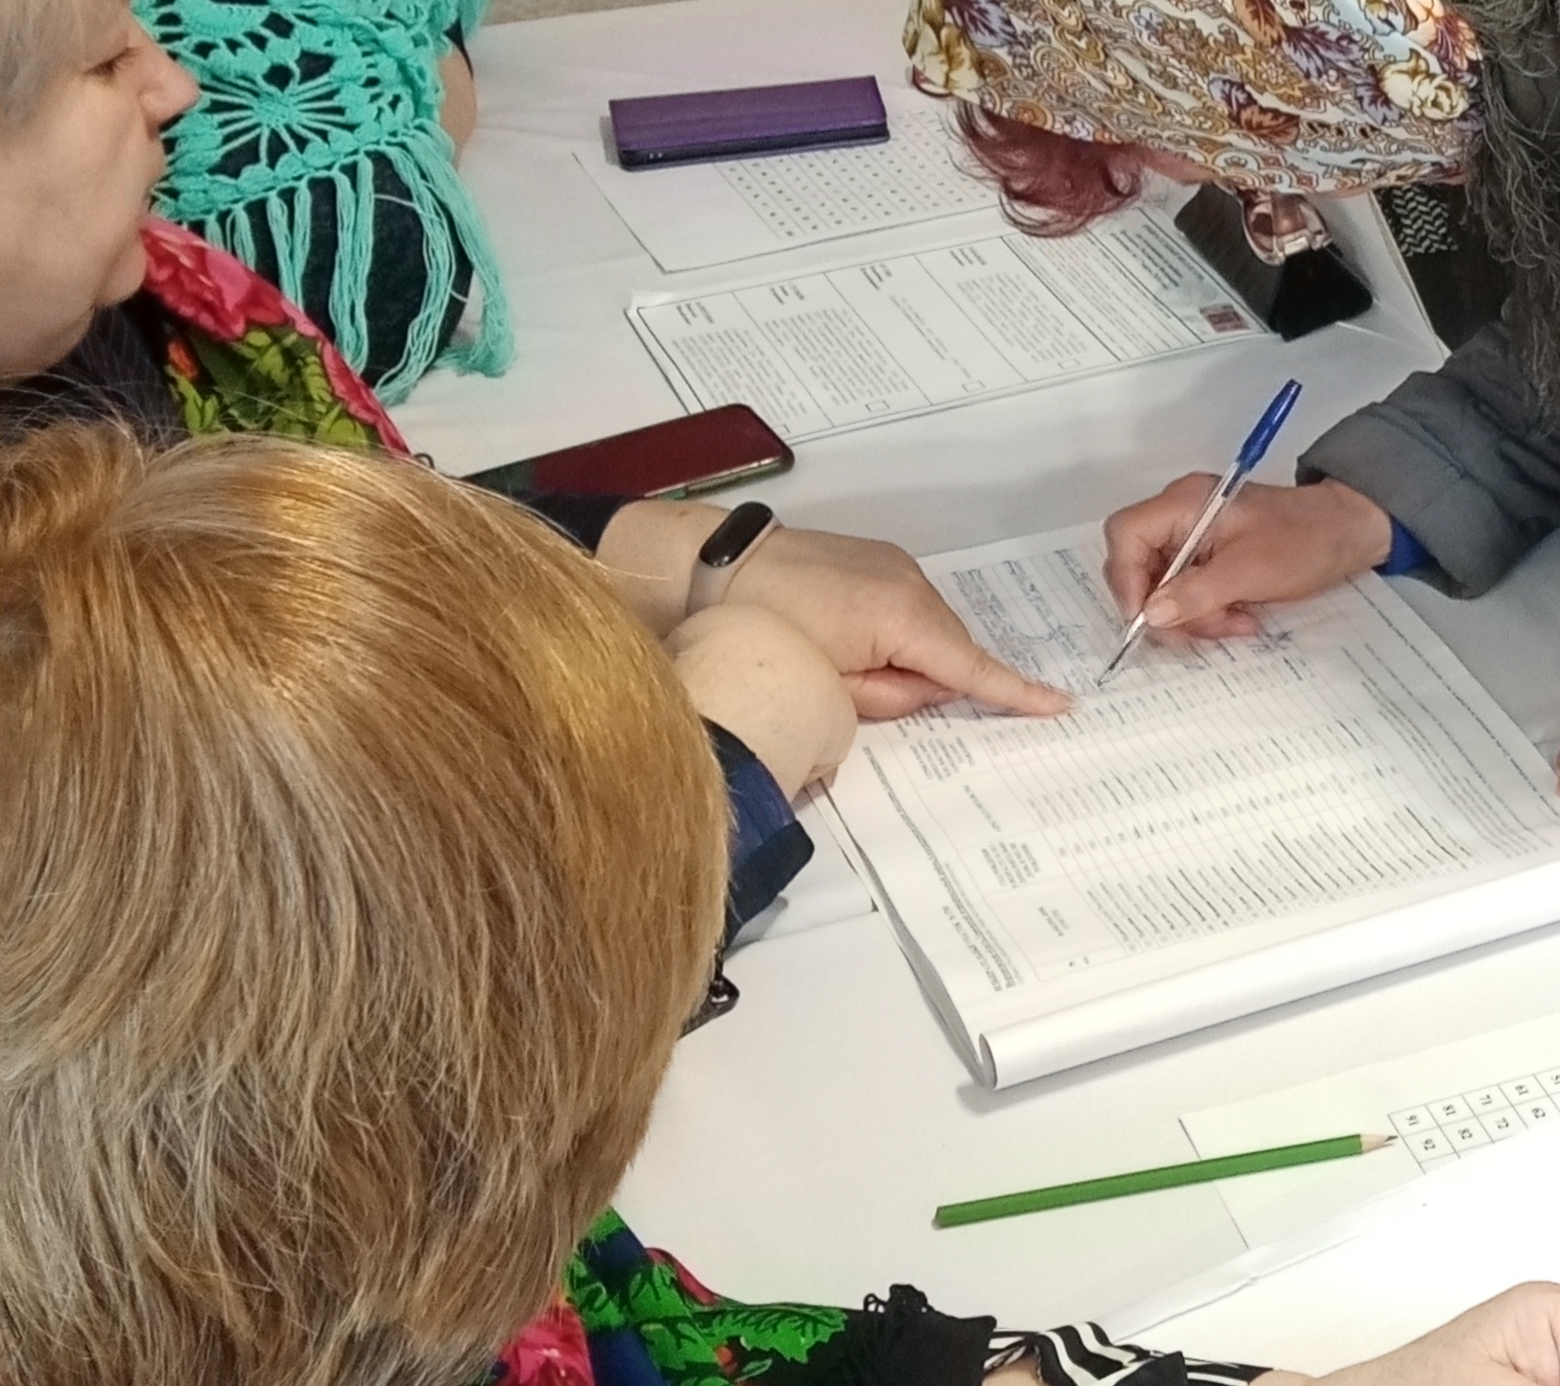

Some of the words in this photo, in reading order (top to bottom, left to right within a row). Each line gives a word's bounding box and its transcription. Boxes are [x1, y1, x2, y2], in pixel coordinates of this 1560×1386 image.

[1478, 1093, 1494, 1107] 71
[1494, 1117, 1510, 1131] 72
[1514, 1084, 1530, 1097] 61
[1531, 1107, 1547, 1120] 62
[1405, 1114, 1420, 1128] 91
[1422, 1138, 1437, 1152] 92
[1442, 1104, 1457, 1118] 81
[1458, 1127, 1474, 1141] 82
